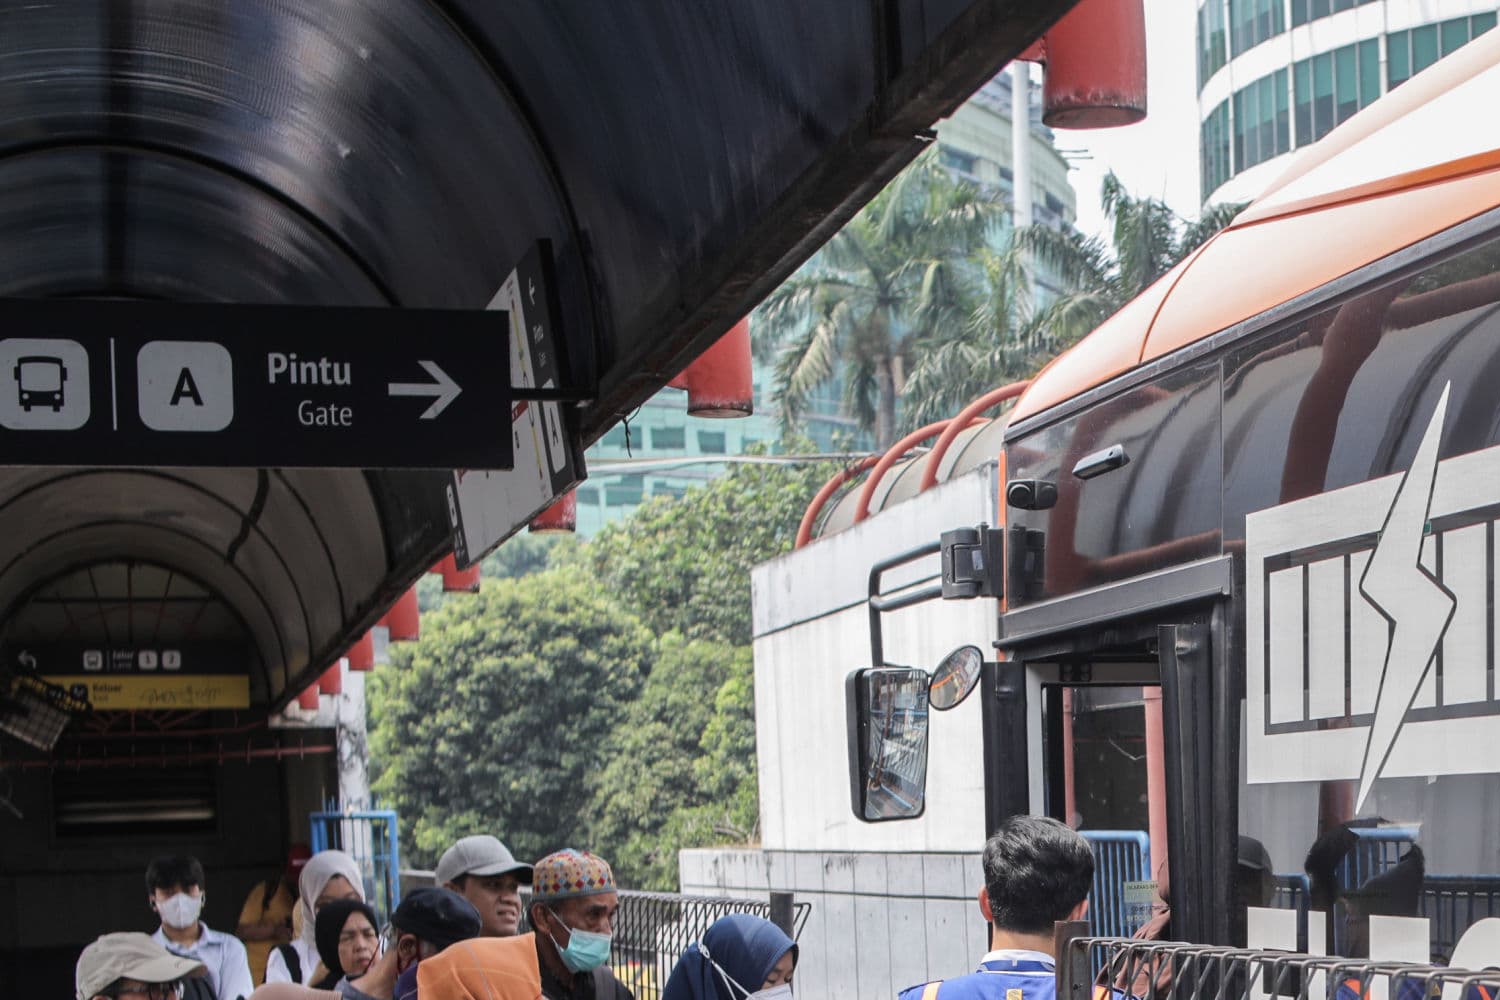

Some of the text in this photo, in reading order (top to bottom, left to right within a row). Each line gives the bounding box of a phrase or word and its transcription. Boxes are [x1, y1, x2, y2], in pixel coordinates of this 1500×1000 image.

[267, 352, 352, 386] Pintu
[169, 366, 204, 407] A
[298, 401, 353, 427] Gate
